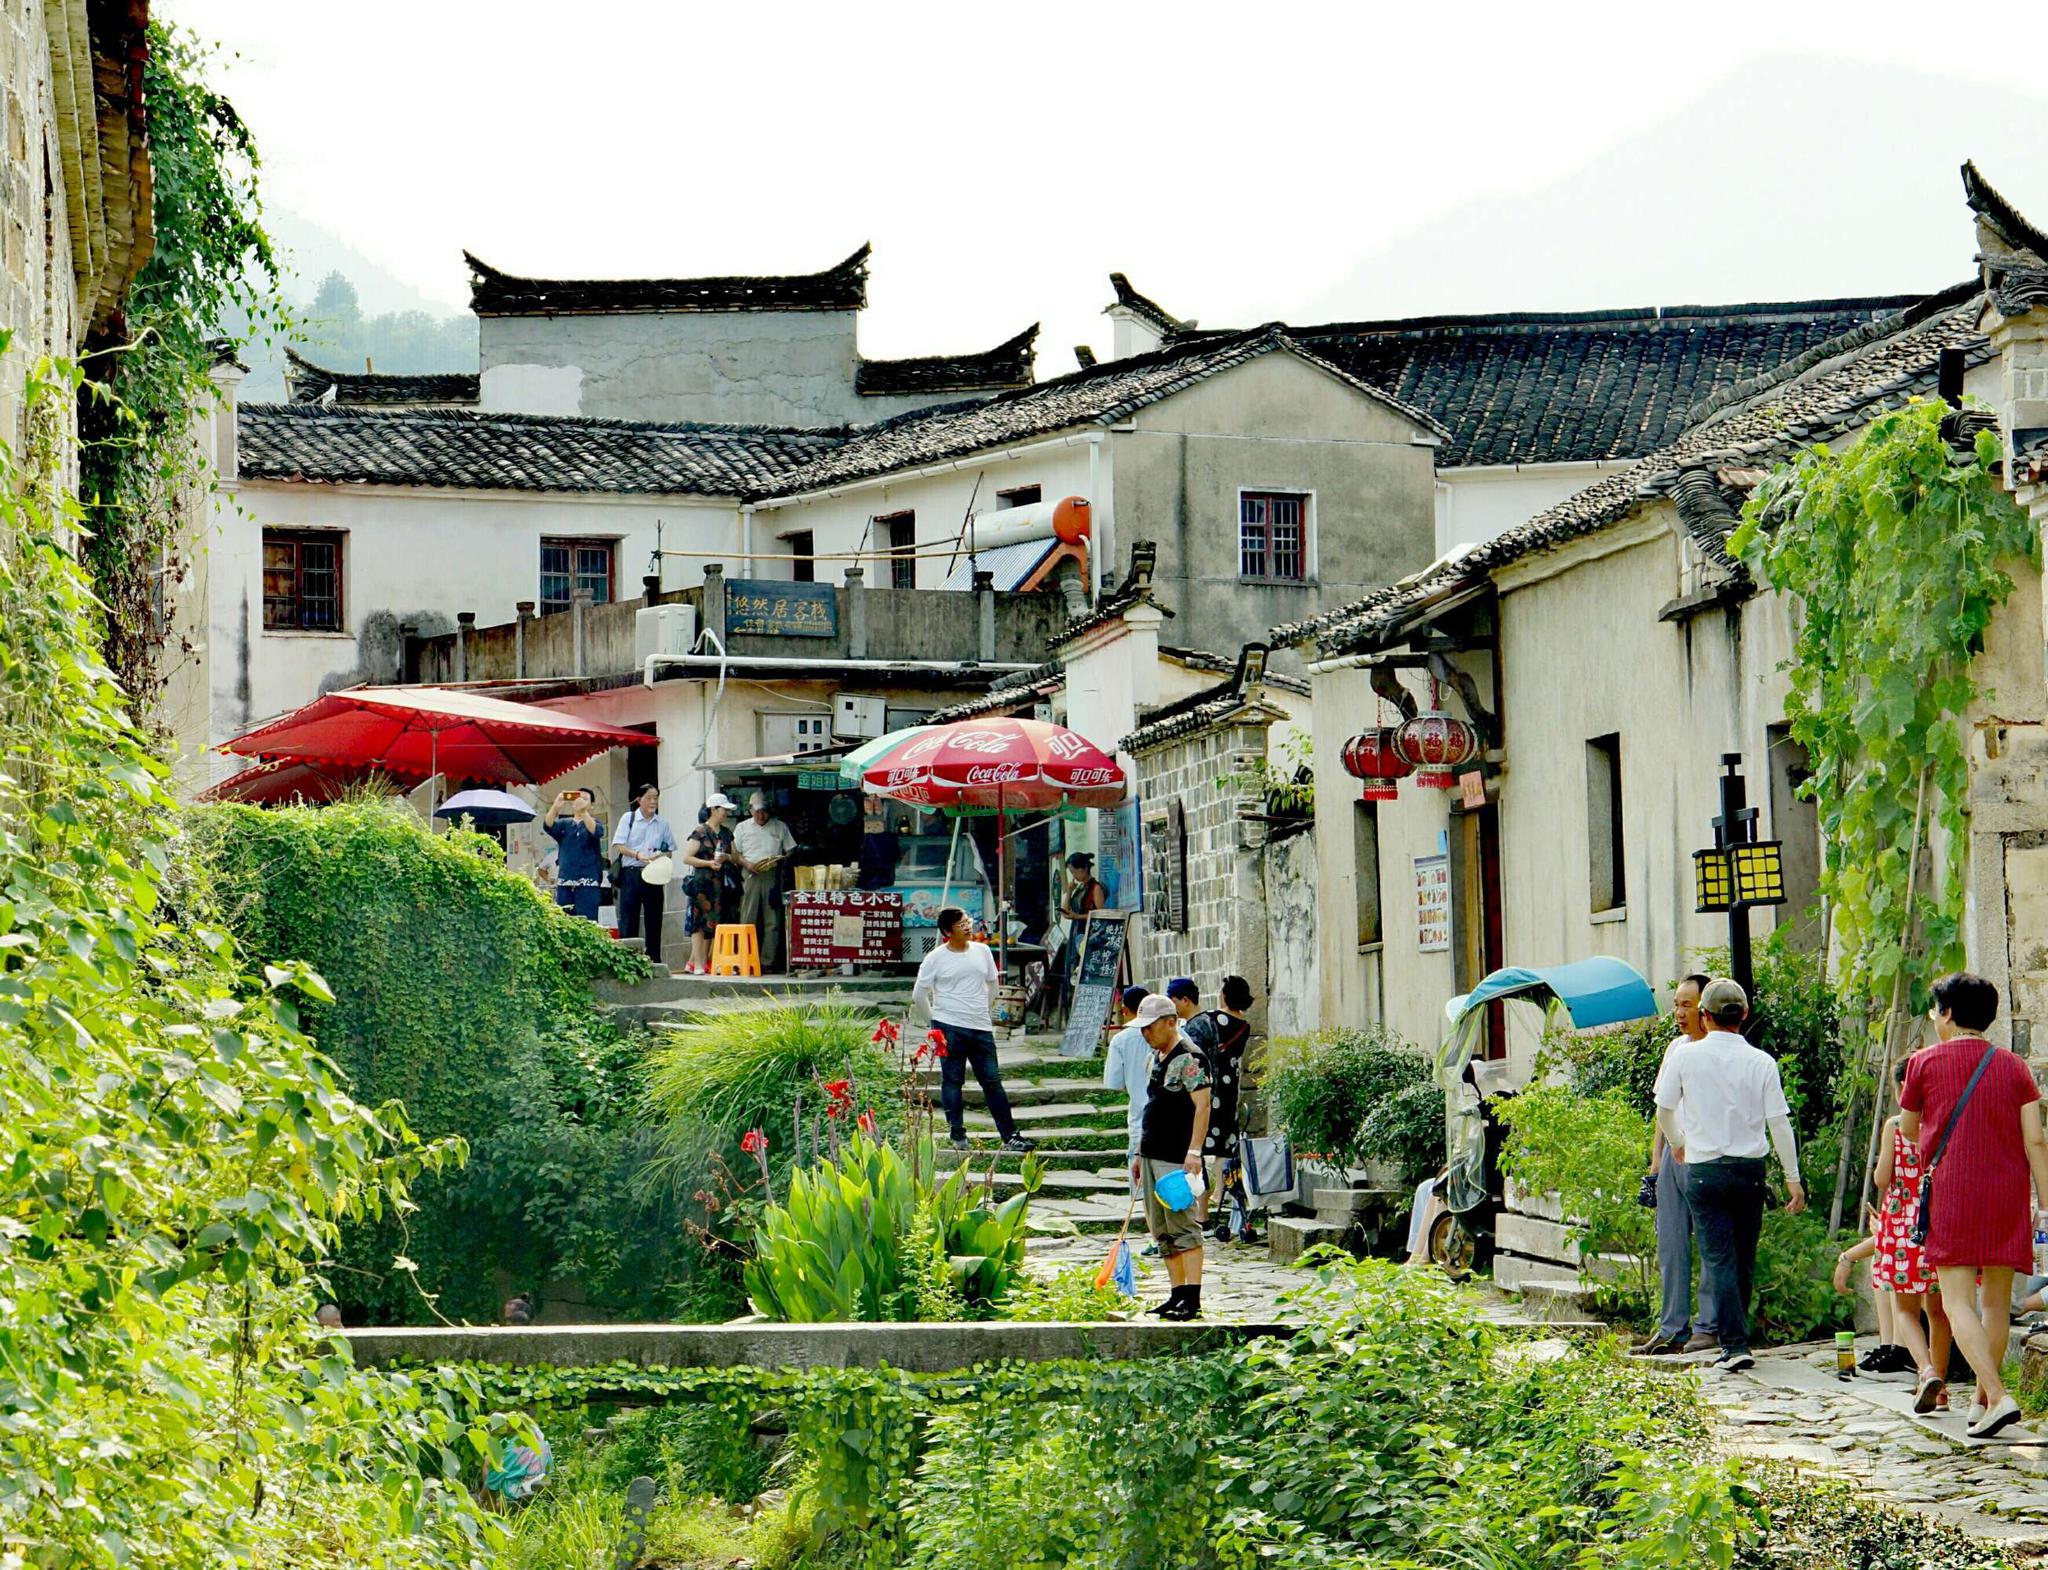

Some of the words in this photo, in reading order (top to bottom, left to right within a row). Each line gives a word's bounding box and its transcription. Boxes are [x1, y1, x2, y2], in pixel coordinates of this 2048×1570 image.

[735, 595, 828, 621] 悠然居客栈
[1424, 731, 1442, 748] 福
[1070, 767, 1114, 785] 可口可乐
[794, 890, 901, 907] 金姐特色小吃
